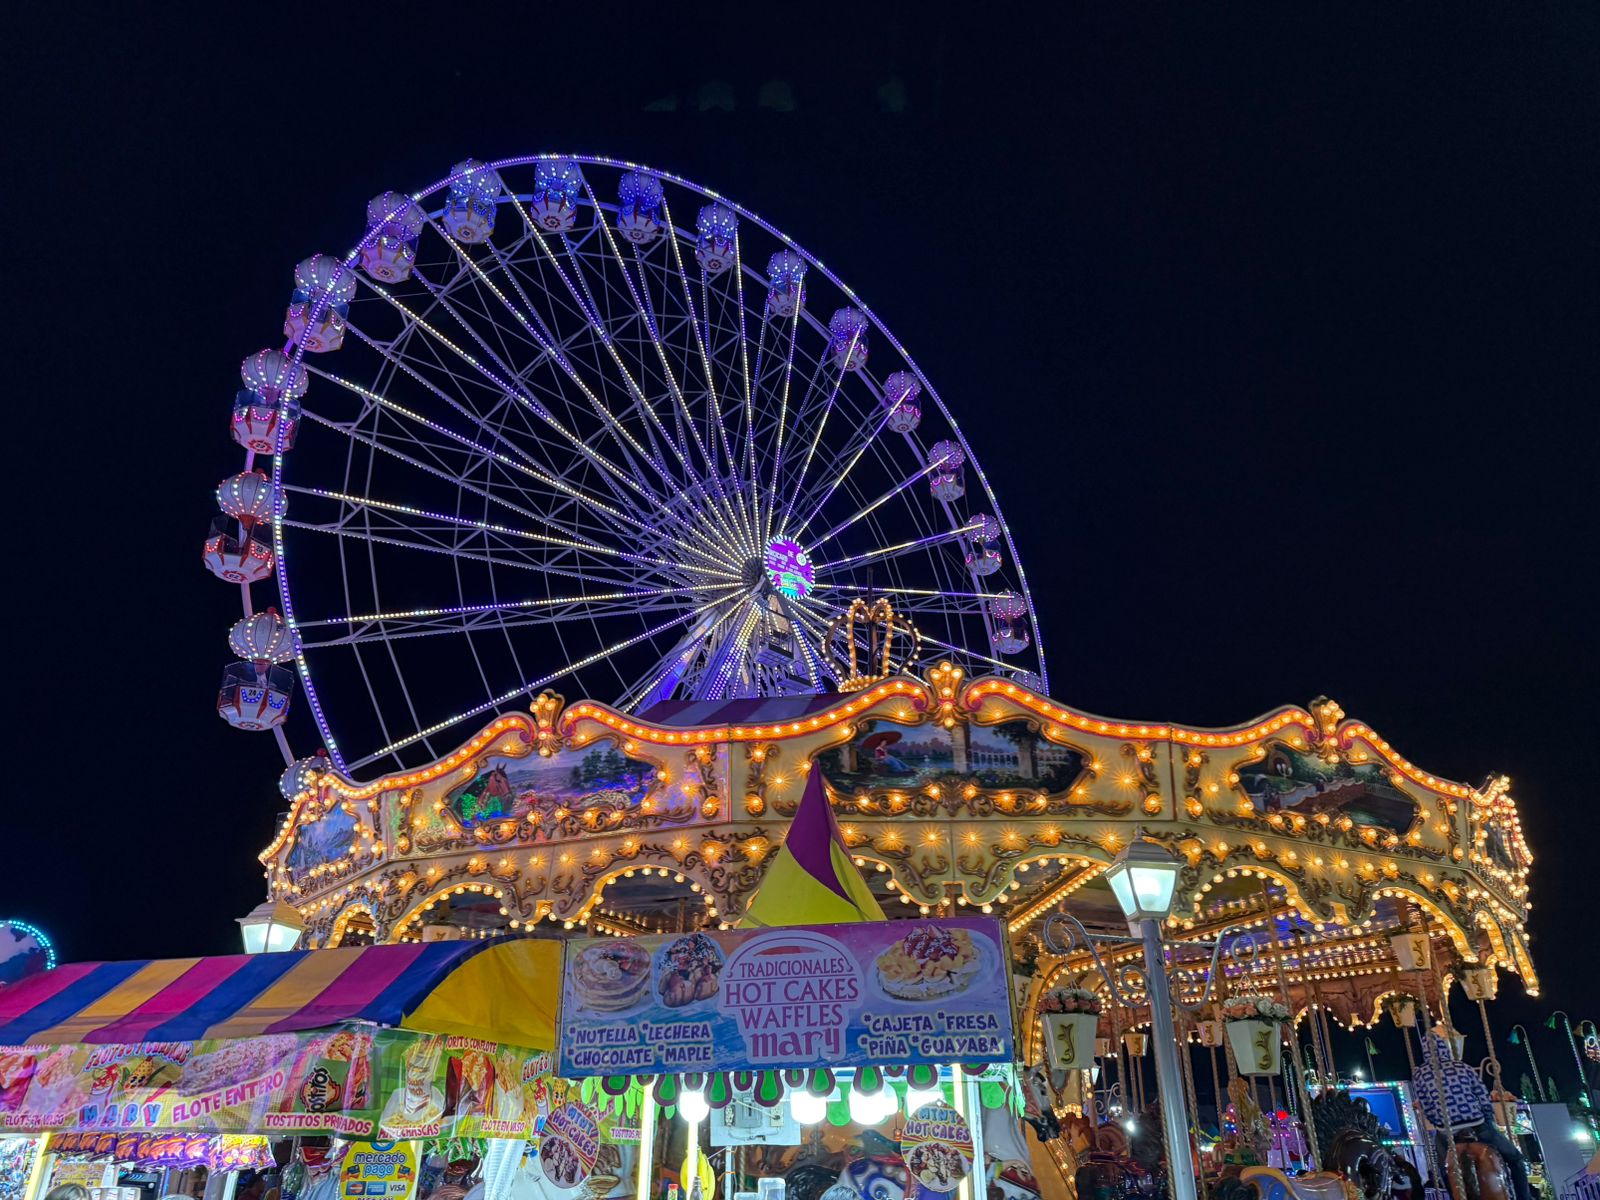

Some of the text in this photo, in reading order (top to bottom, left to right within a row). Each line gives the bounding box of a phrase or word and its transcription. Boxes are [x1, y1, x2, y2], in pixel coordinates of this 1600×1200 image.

[739, 958, 844, 978] TRADICIONALES
[725, 977, 859, 1005] HOT CAKES
[741, 1004, 843, 1029] WAFFLES
[750, 1028, 840, 1057] mary
[173, 1071, 284, 1123] ELOTE ENTERO
[80, 1103, 161, 1128] MARY
[265, 1114, 320, 1127] TOSTITOS
[552, 1110, 570, 1134] HOT
[568, 1126, 597, 1157] CAKES
[906, 1121, 971, 1141] HOT CAKES
[355, 1150, 406, 1164] mercado
[363, 1164, 395, 1179] pago
[389, 1184, 406, 1192] VISA
